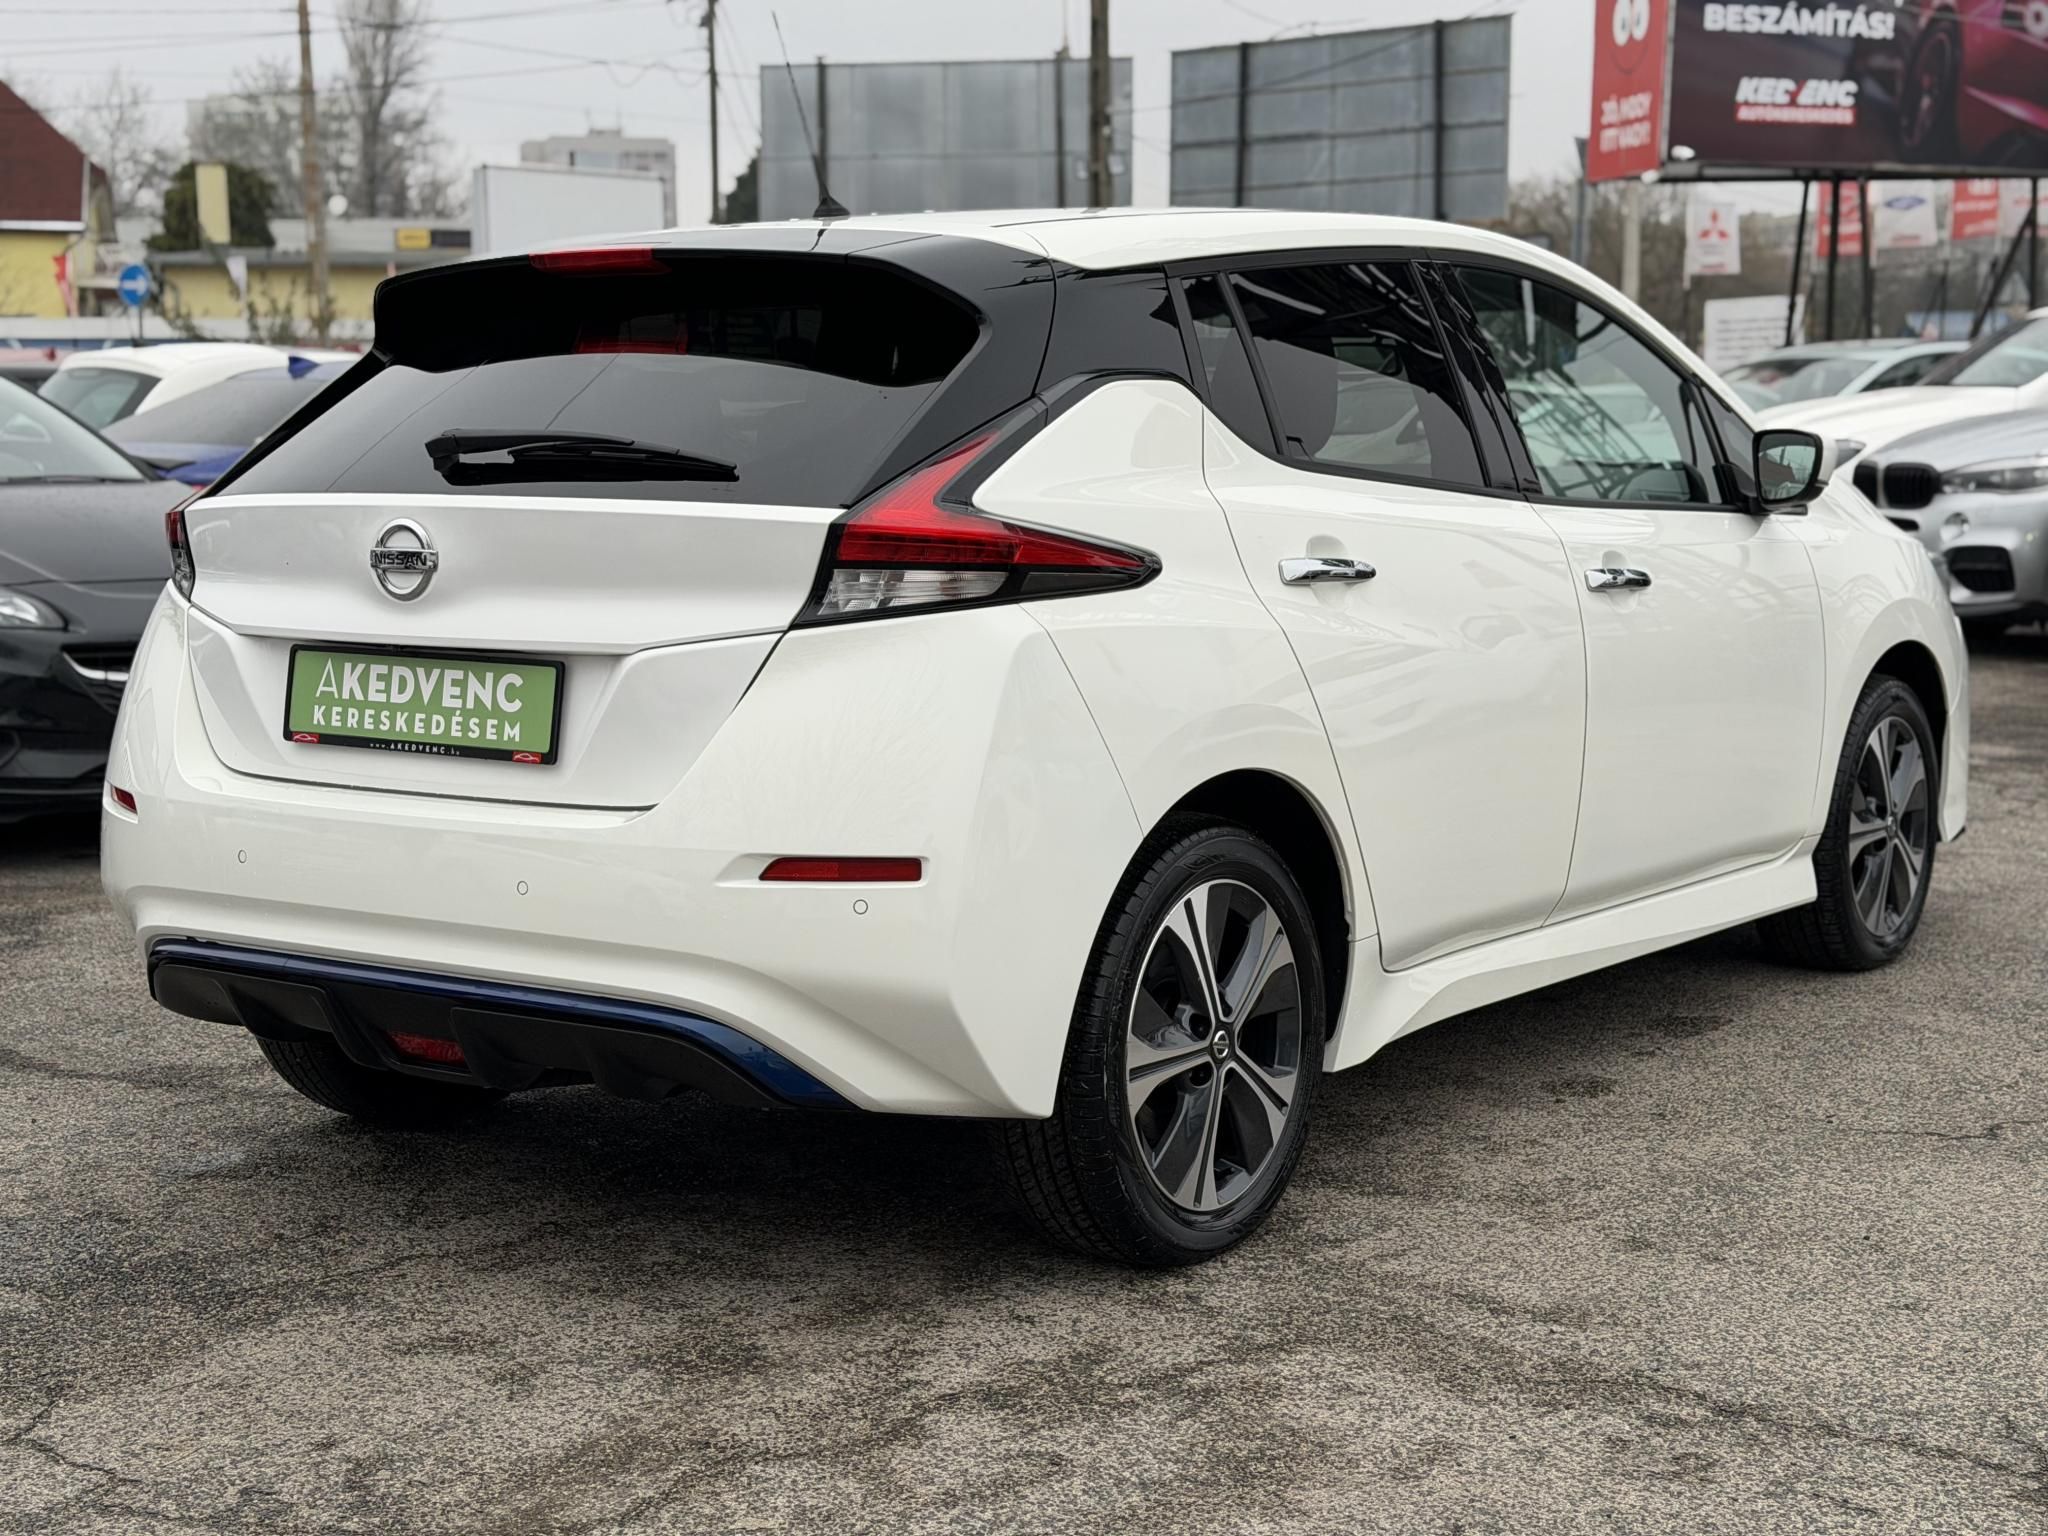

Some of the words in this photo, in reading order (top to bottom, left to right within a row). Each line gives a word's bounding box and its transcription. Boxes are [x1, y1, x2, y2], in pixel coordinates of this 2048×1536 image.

[1703, 1, 1896, 40] BESZÁMÍTÁS!
[373, 552, 428, 567] NISSAN
[315, 657, 524, 713] AKEDVENC
[313, 704, 521, 742] KERESKEDÉSEM
